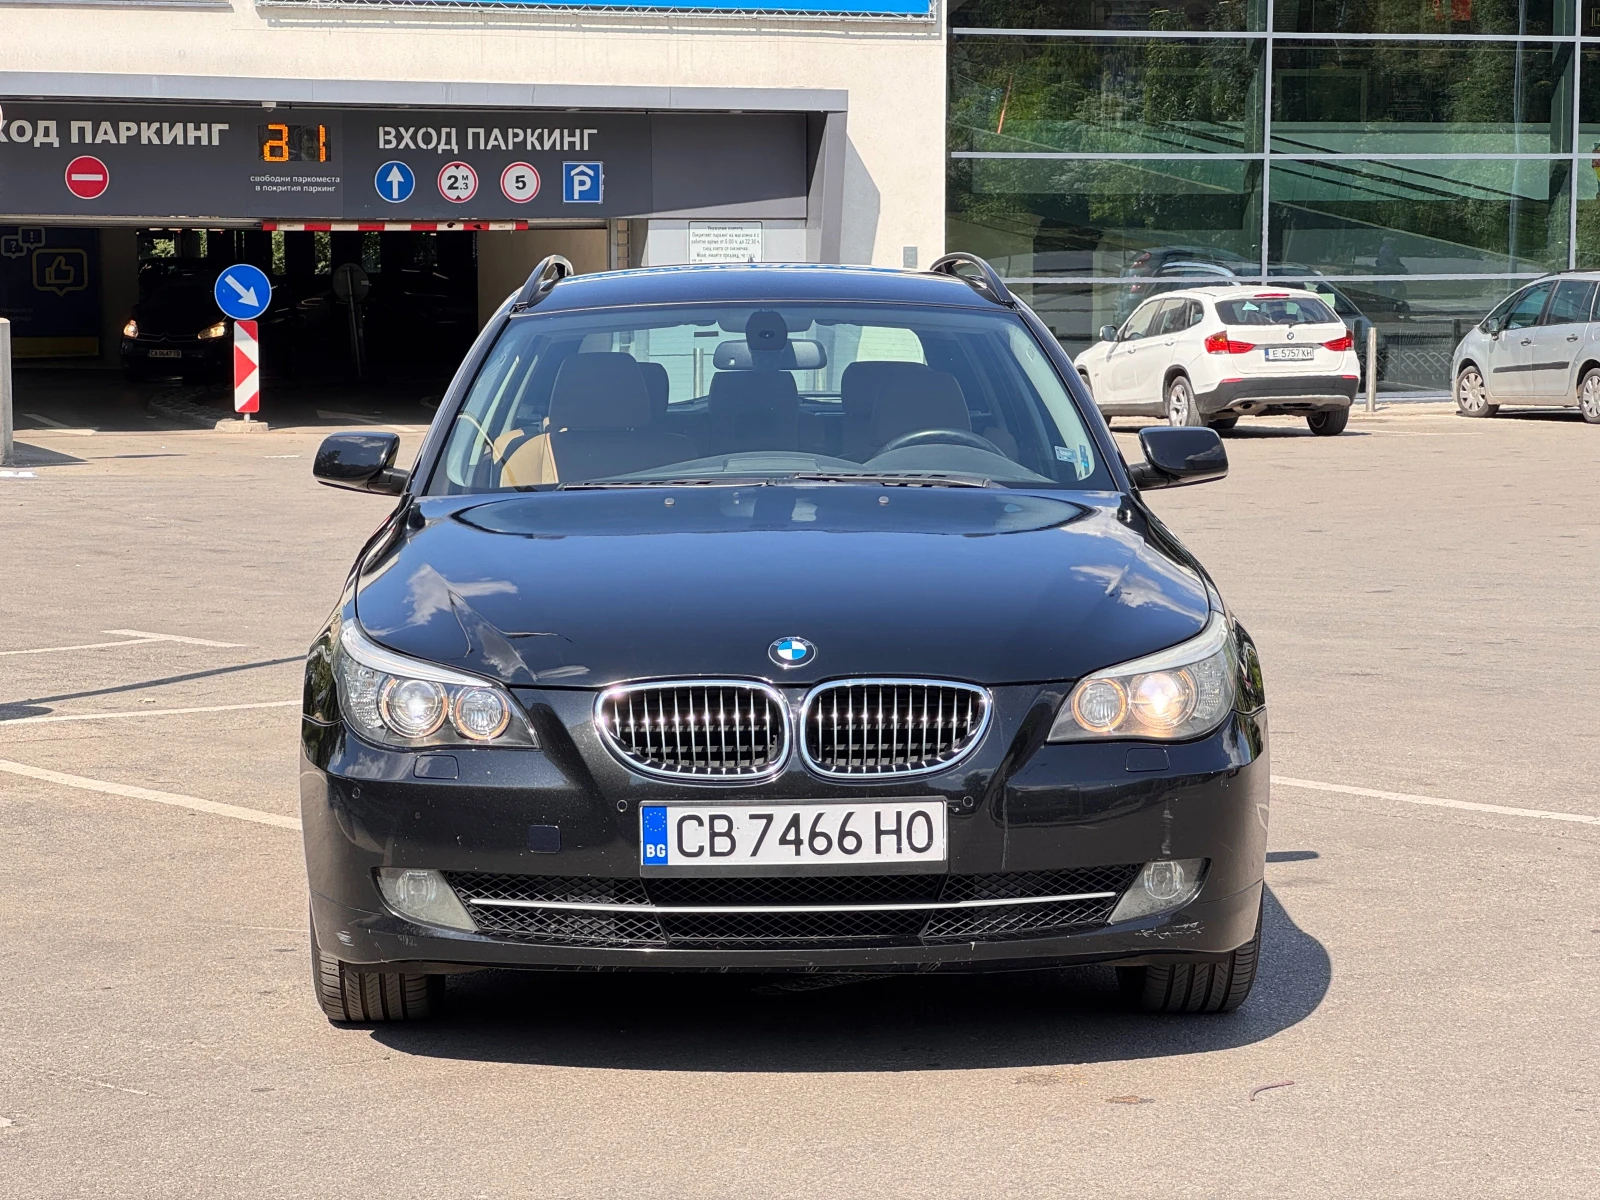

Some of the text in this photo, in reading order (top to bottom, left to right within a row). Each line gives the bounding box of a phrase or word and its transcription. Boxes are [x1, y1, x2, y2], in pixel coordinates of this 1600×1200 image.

[70, 120, 229, 146] ПАРКИНГ
[378, 126, 598, 154] ВХОД ПАРКИНГ
[250, 175, 340, 184] свободни паркоместа
[515, 174, 527, 191] 5
[303, 185, 336, 193] паркинг
[1281, 349, 1300, 358] 5757
[1301, 349, 1312, 357] XH
[676, 813, 737, 858] CB
[748, 811, 863, 857] 7466
[646, 844, 666, 858] BG
